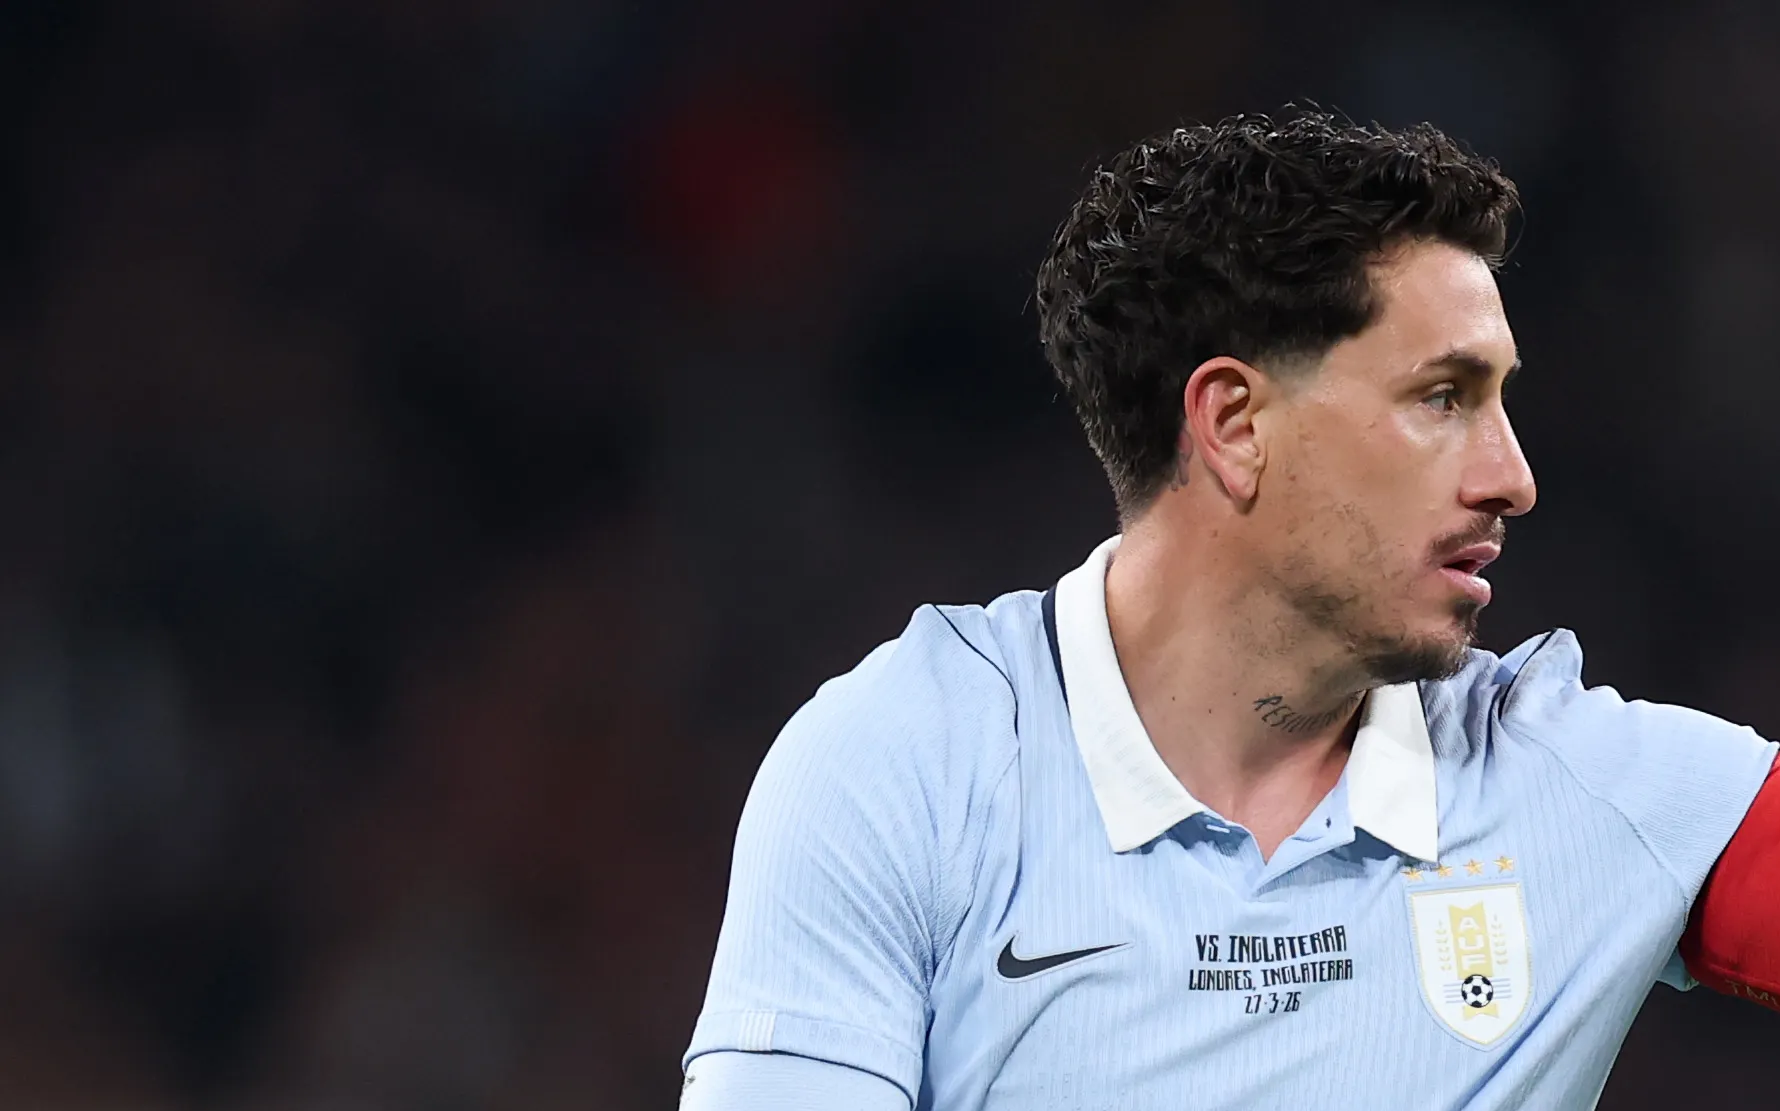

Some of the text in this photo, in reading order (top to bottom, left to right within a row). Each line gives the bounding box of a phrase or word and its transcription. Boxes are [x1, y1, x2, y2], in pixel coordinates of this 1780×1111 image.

[1195, 924, 1347, 963] VS. INGLATERRA
[1457, 915, 1487, 972] AUF
[1188, 958, 1353, 991] LONDRES, INGLATERRA
